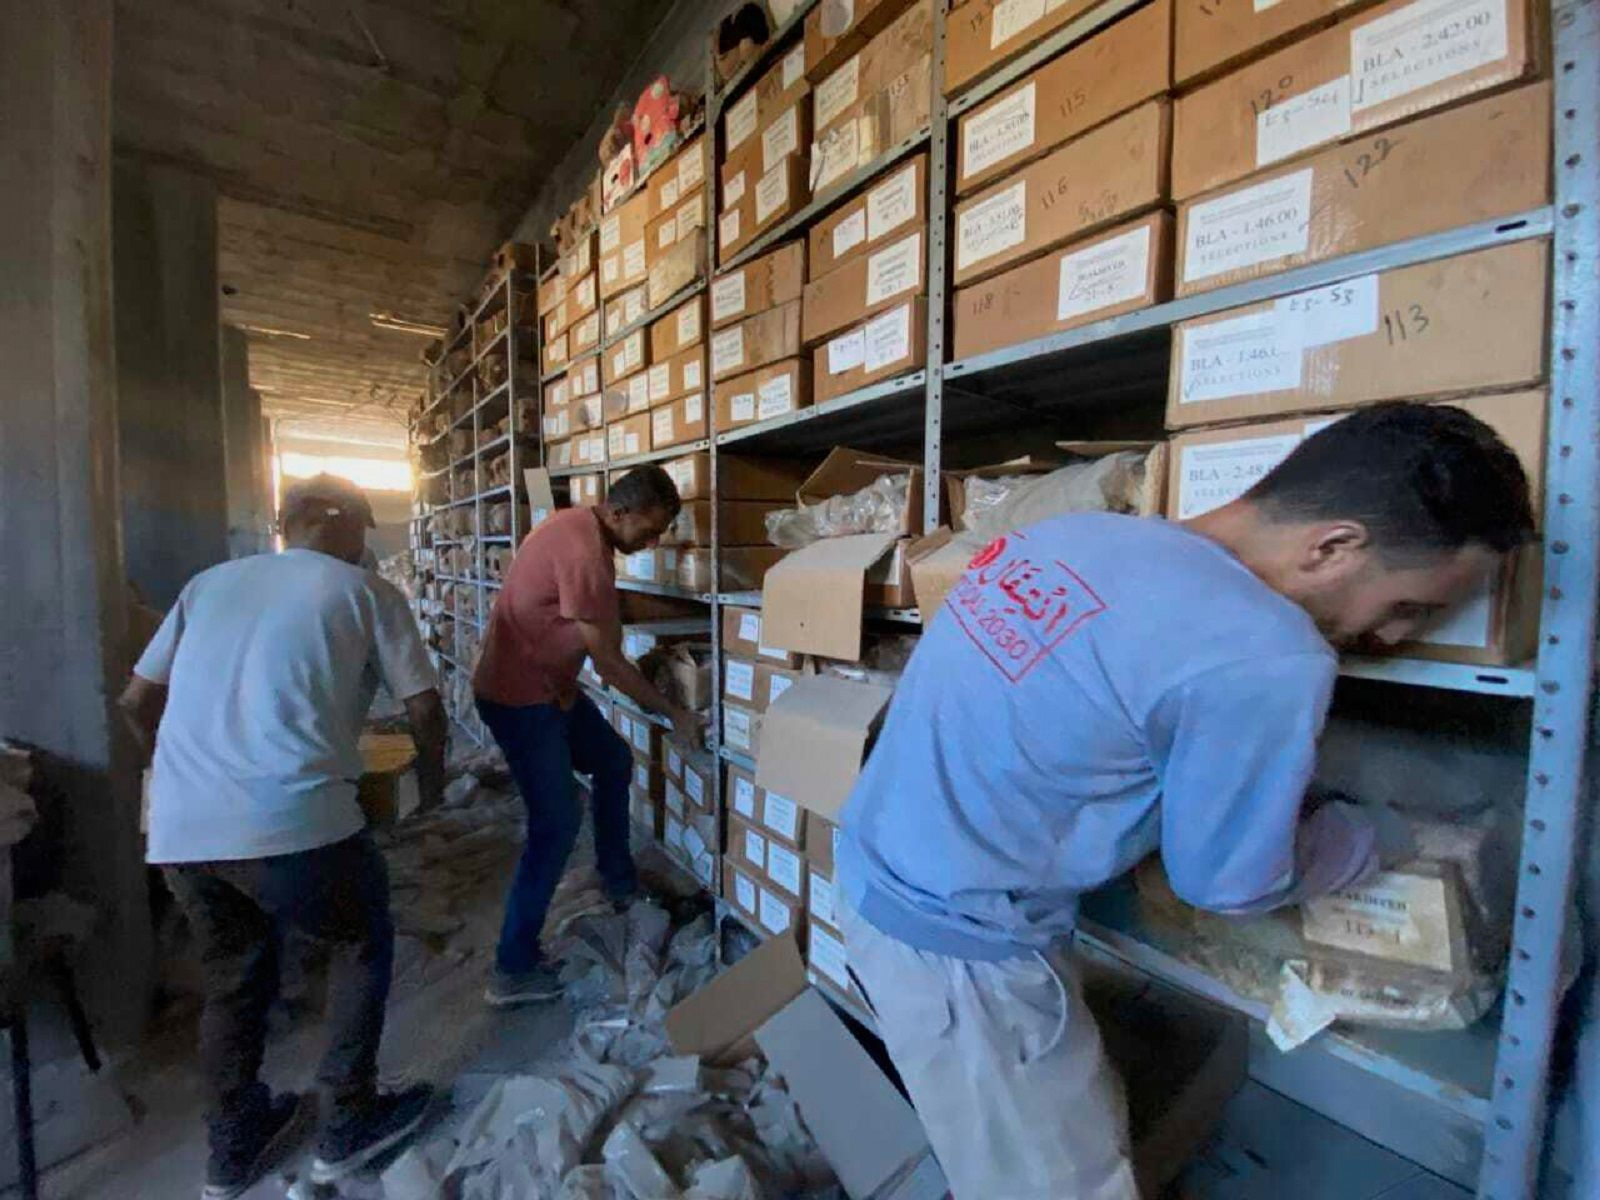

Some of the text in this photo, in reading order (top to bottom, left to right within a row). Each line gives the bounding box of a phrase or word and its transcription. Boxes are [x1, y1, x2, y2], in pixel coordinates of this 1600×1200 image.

[1363, 48, 1404, 72] BLA
[1042, 176, 1068, 210] 116
[1195, 230, 1228, 249] BLA
[1384, 304, 1430, 346] 113
[1190, 356, 1222, 371] BLA
[1189, 468, 1220, 481] BLA
[978, 613, 1030, 660] 2030
